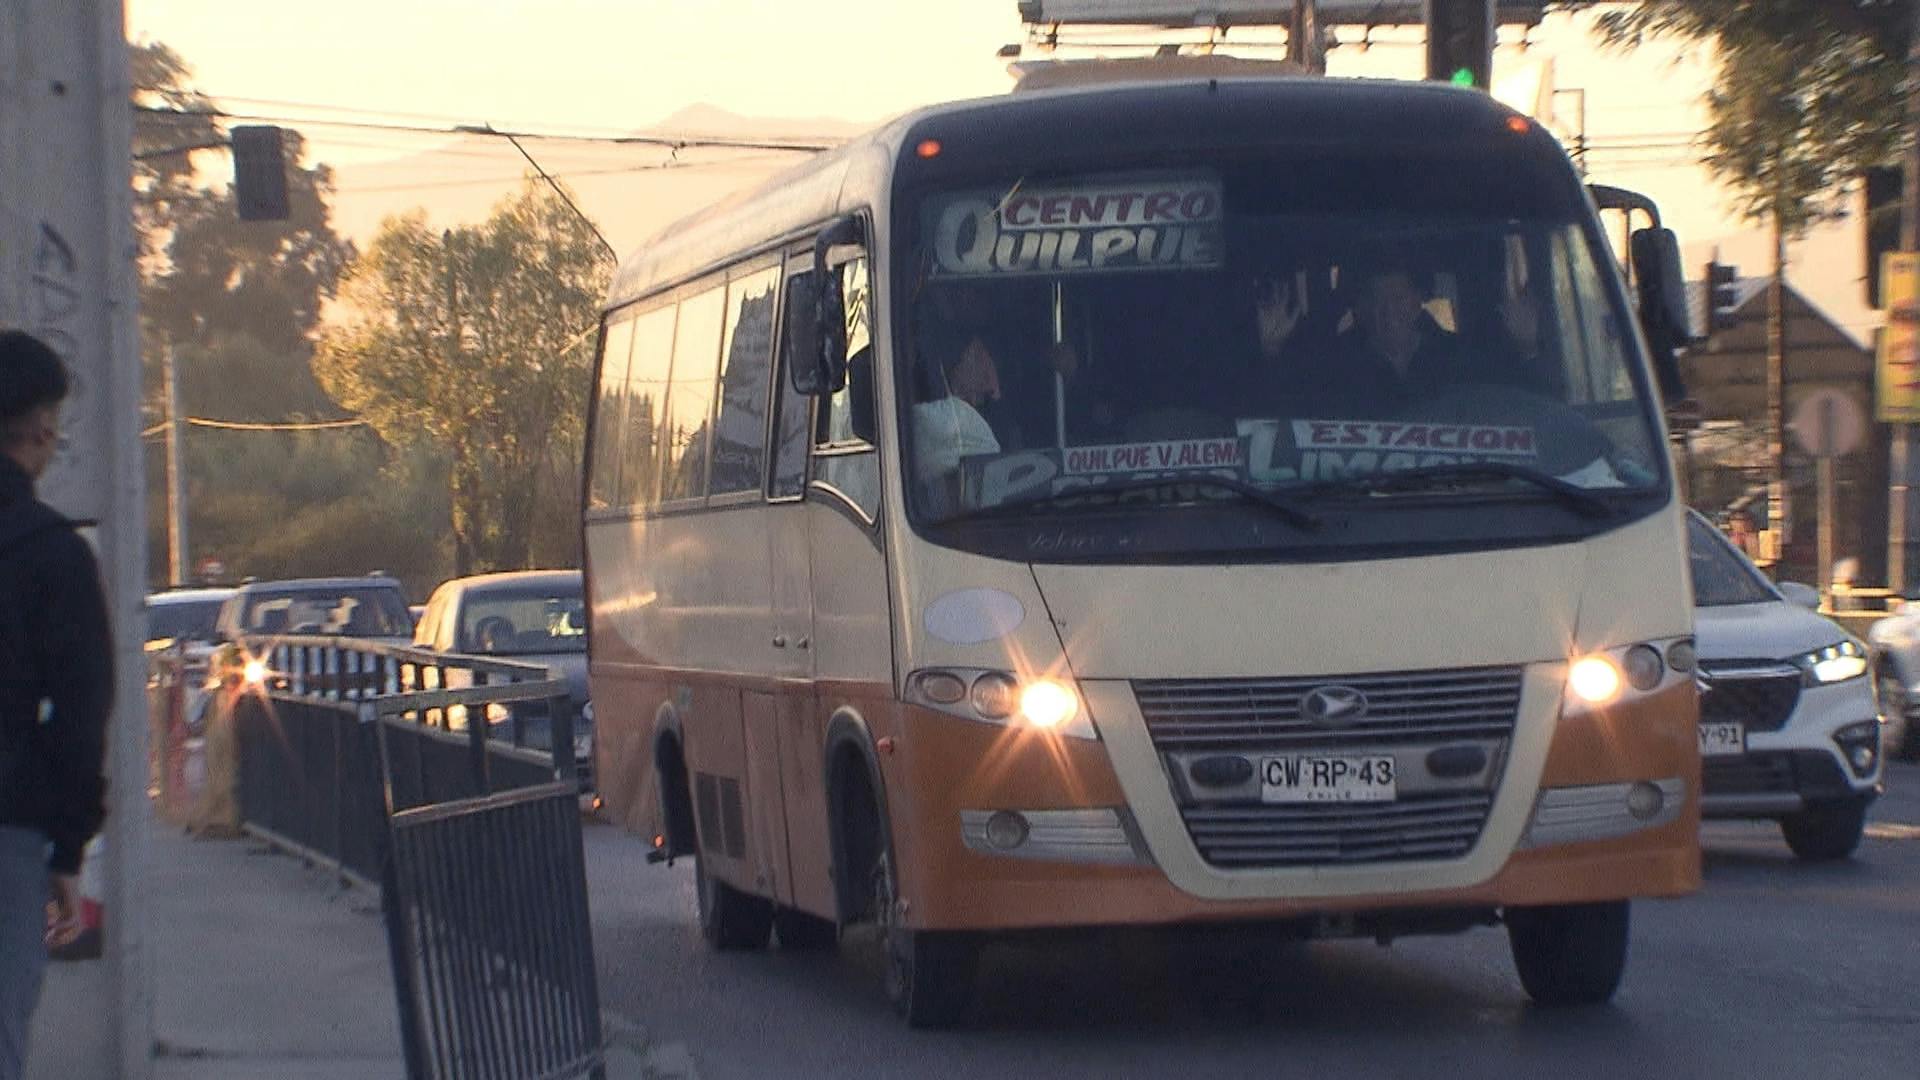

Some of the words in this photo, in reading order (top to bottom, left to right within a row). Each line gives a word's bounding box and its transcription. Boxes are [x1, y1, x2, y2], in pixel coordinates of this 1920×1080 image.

[1003, 191, 1217, 226] CENTRO
[1310, 423, 1533, 450] ESTACION
[1068, 446, 1150, 472] QUILPUE
